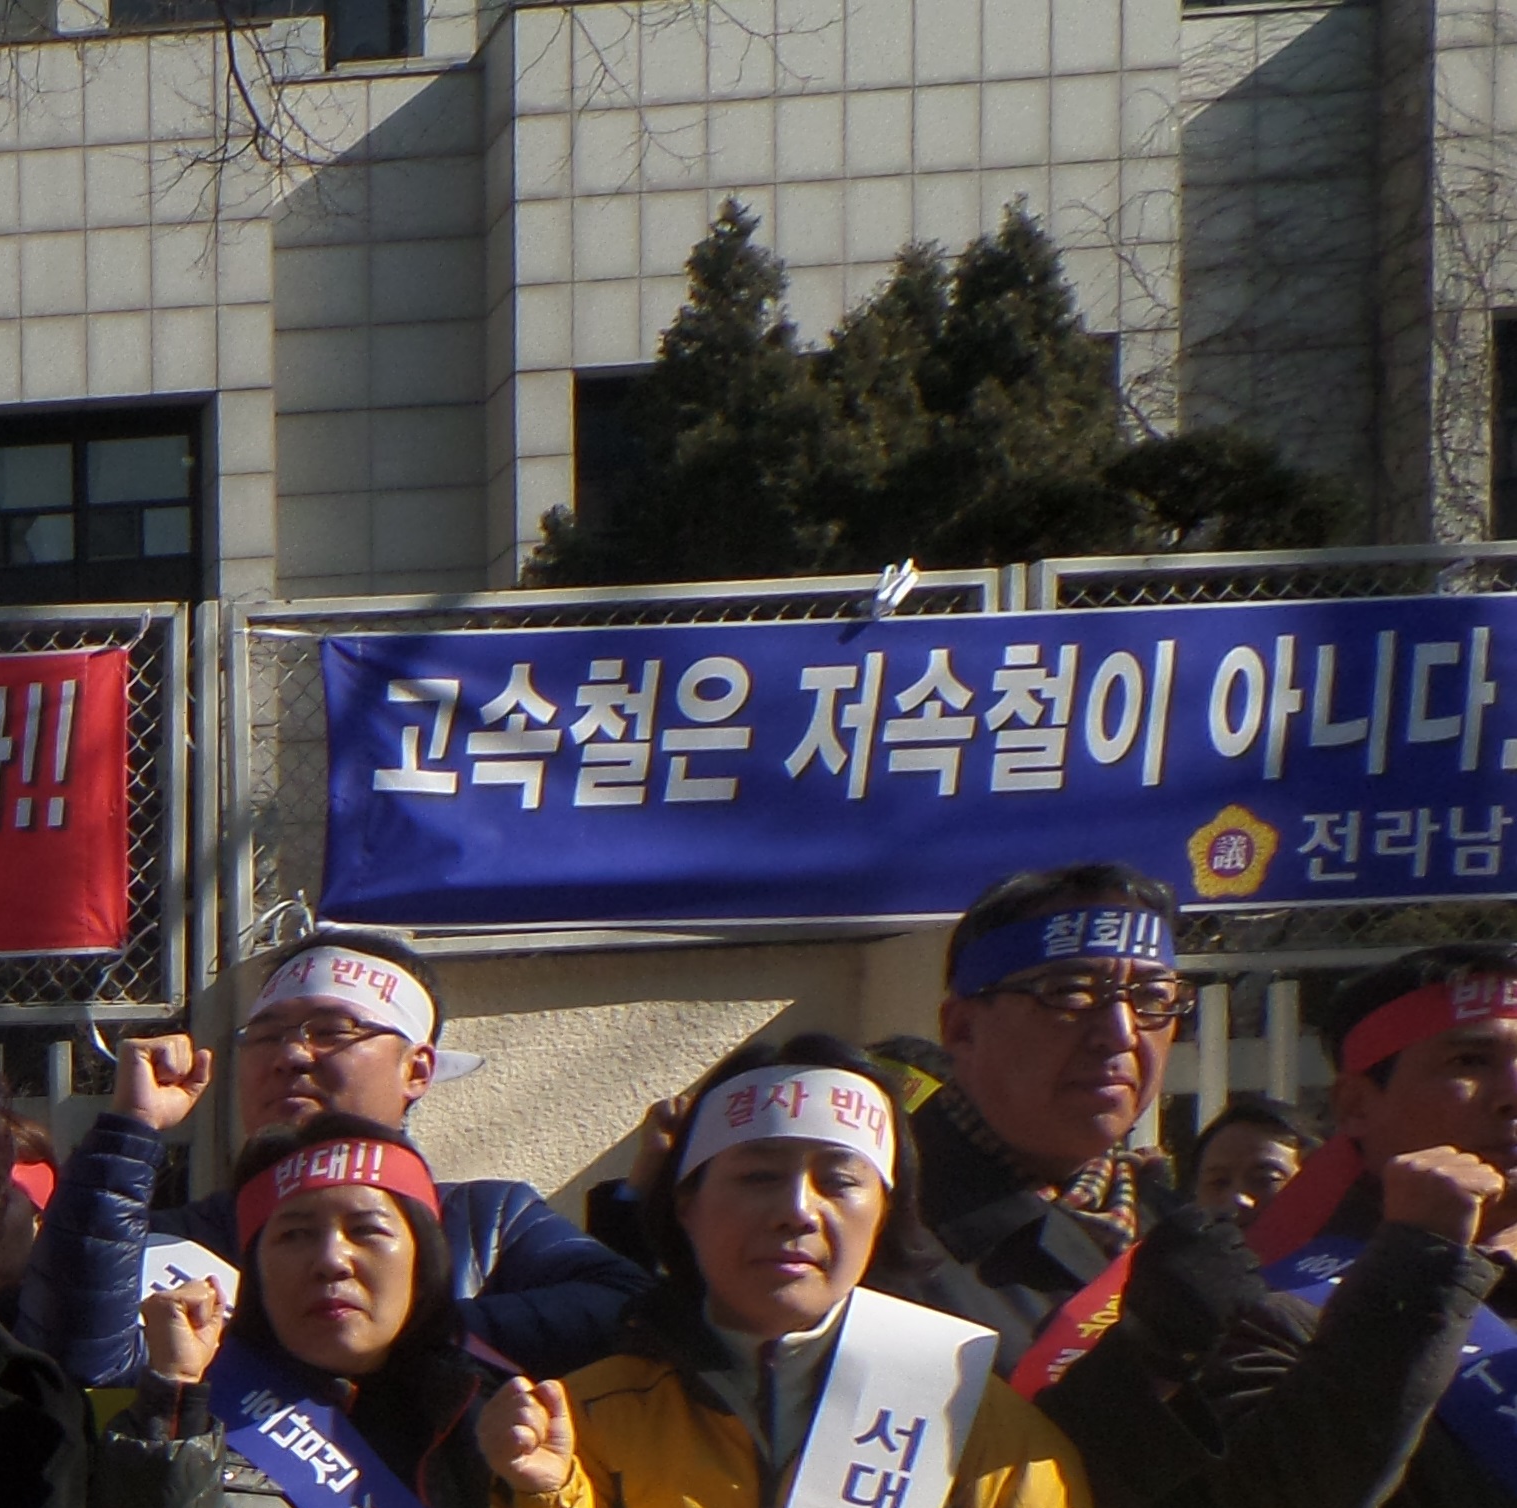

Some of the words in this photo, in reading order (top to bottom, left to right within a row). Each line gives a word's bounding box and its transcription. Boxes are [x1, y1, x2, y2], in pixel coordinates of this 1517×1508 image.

[372, 655, 753, 810] 고속철은
[783, 639, 1177, 801] 저속철이
[1043, 911, 1161, 958] 철회!!
[331, 958, 398, 1003] 반대
[724, 1080, 809, 1128] 결사
[273, 1143, 384, 1199] 반대!!
